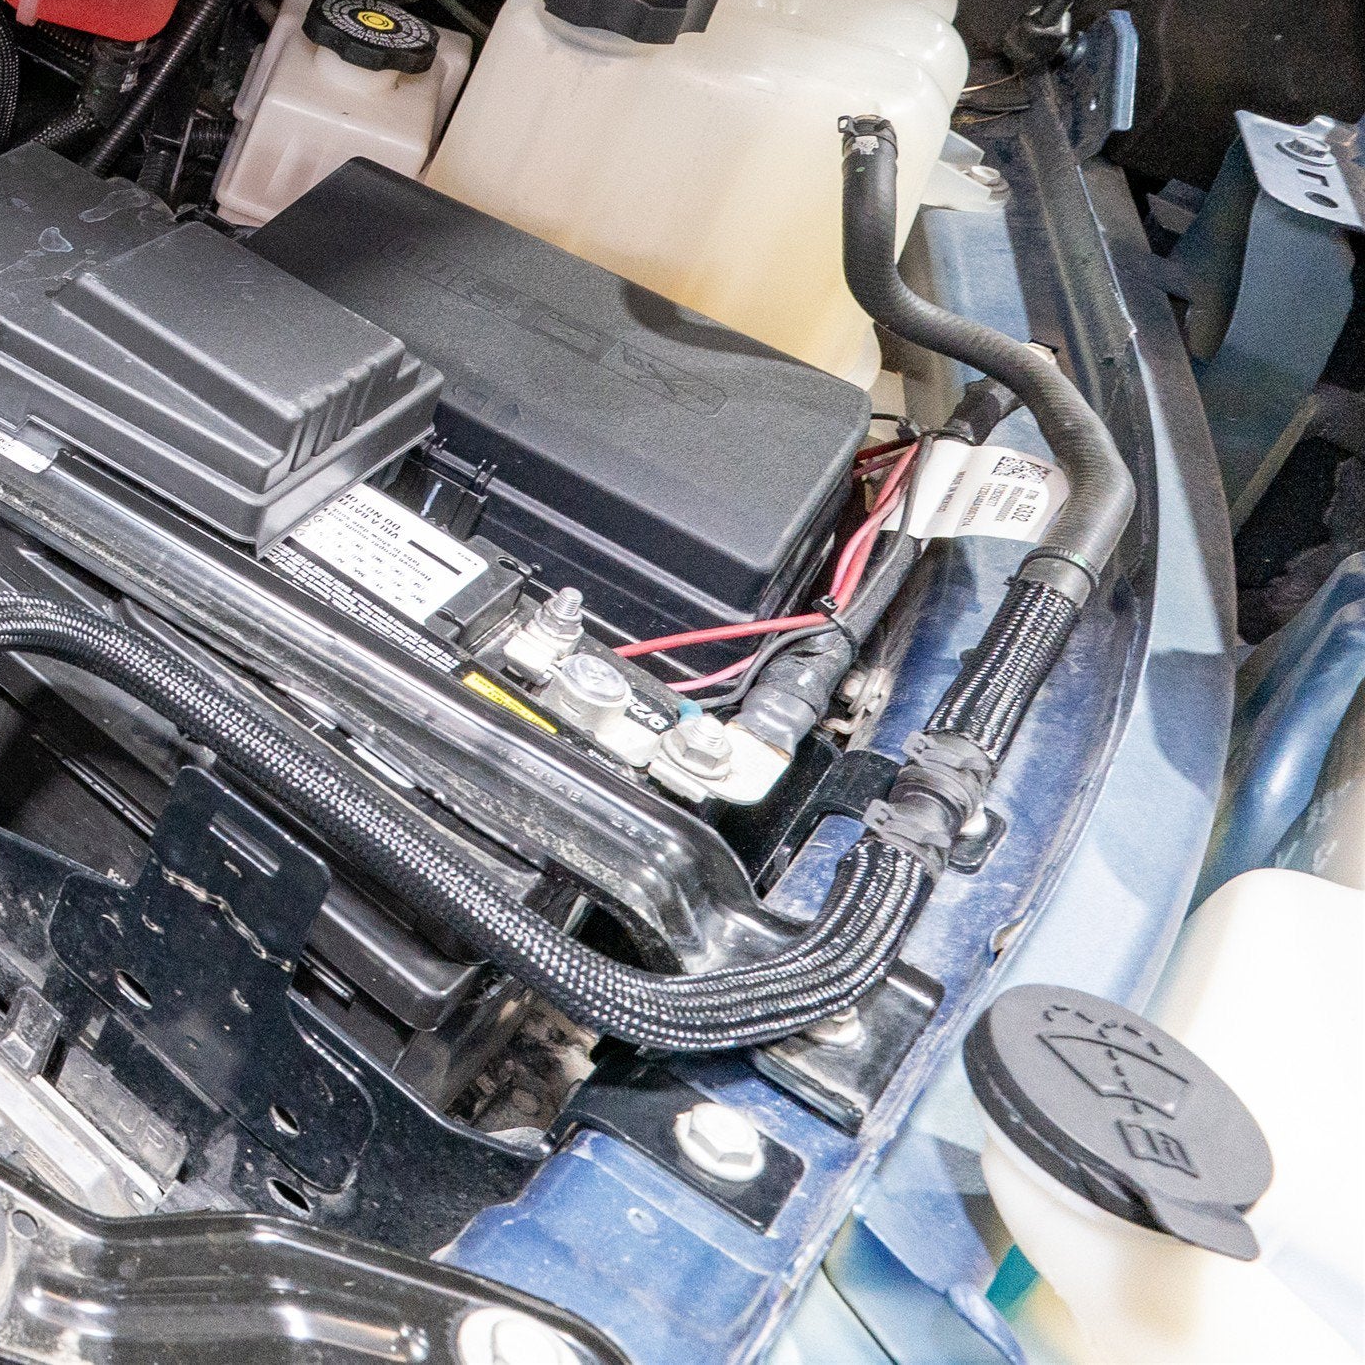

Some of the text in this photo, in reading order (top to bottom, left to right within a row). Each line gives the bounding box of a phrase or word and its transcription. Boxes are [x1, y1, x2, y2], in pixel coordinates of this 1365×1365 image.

[950, 471, 966, 485] MADE
[935, 493, 954, 512] MEXICO
[1010, 503, 1037, 523] 6332
[117, 1101, 168, 1151] UP
